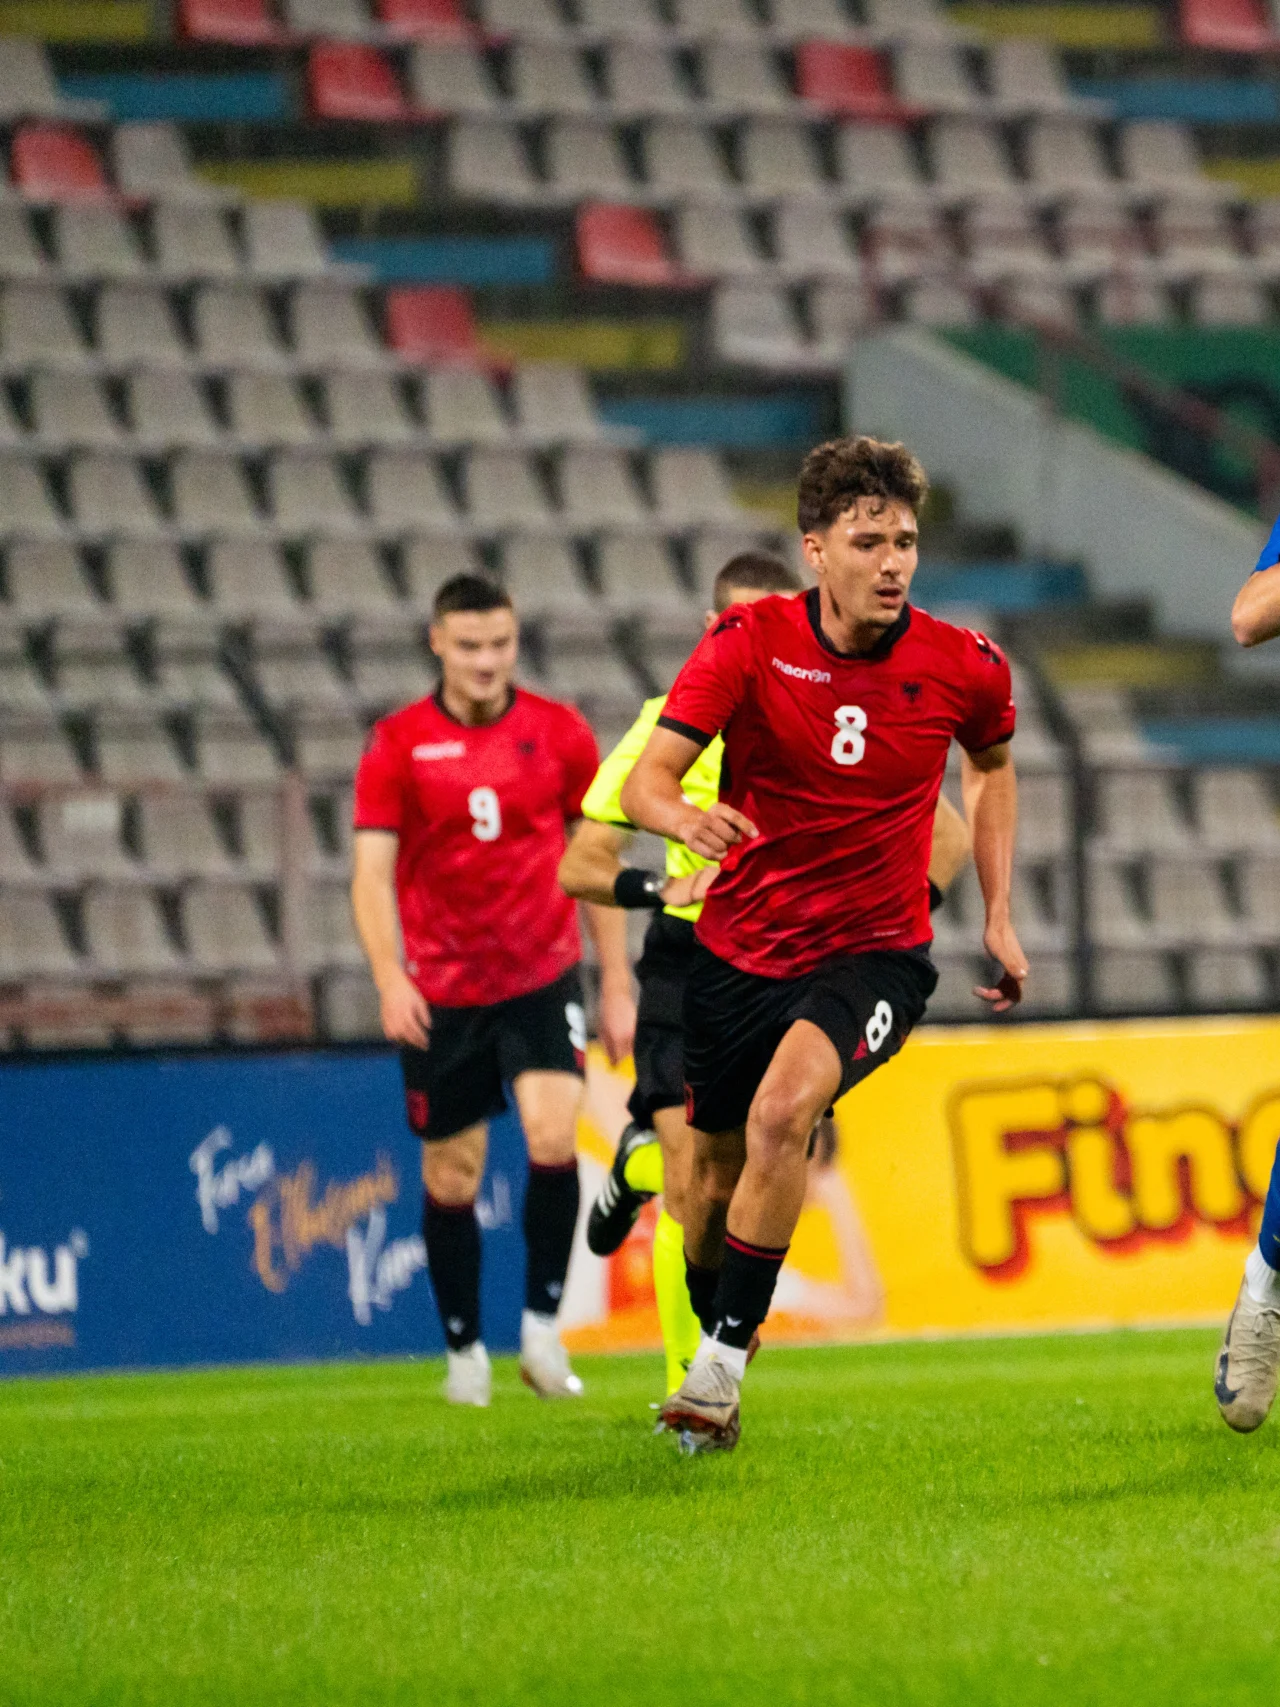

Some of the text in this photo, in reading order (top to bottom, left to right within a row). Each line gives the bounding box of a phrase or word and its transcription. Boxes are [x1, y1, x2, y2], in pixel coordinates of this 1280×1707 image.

[772, 656, 833, 683] macron
[831, 704, 868, 766] 8
[467, 786, 502, 842] 9
[866, 999, 893, 1053] 8
